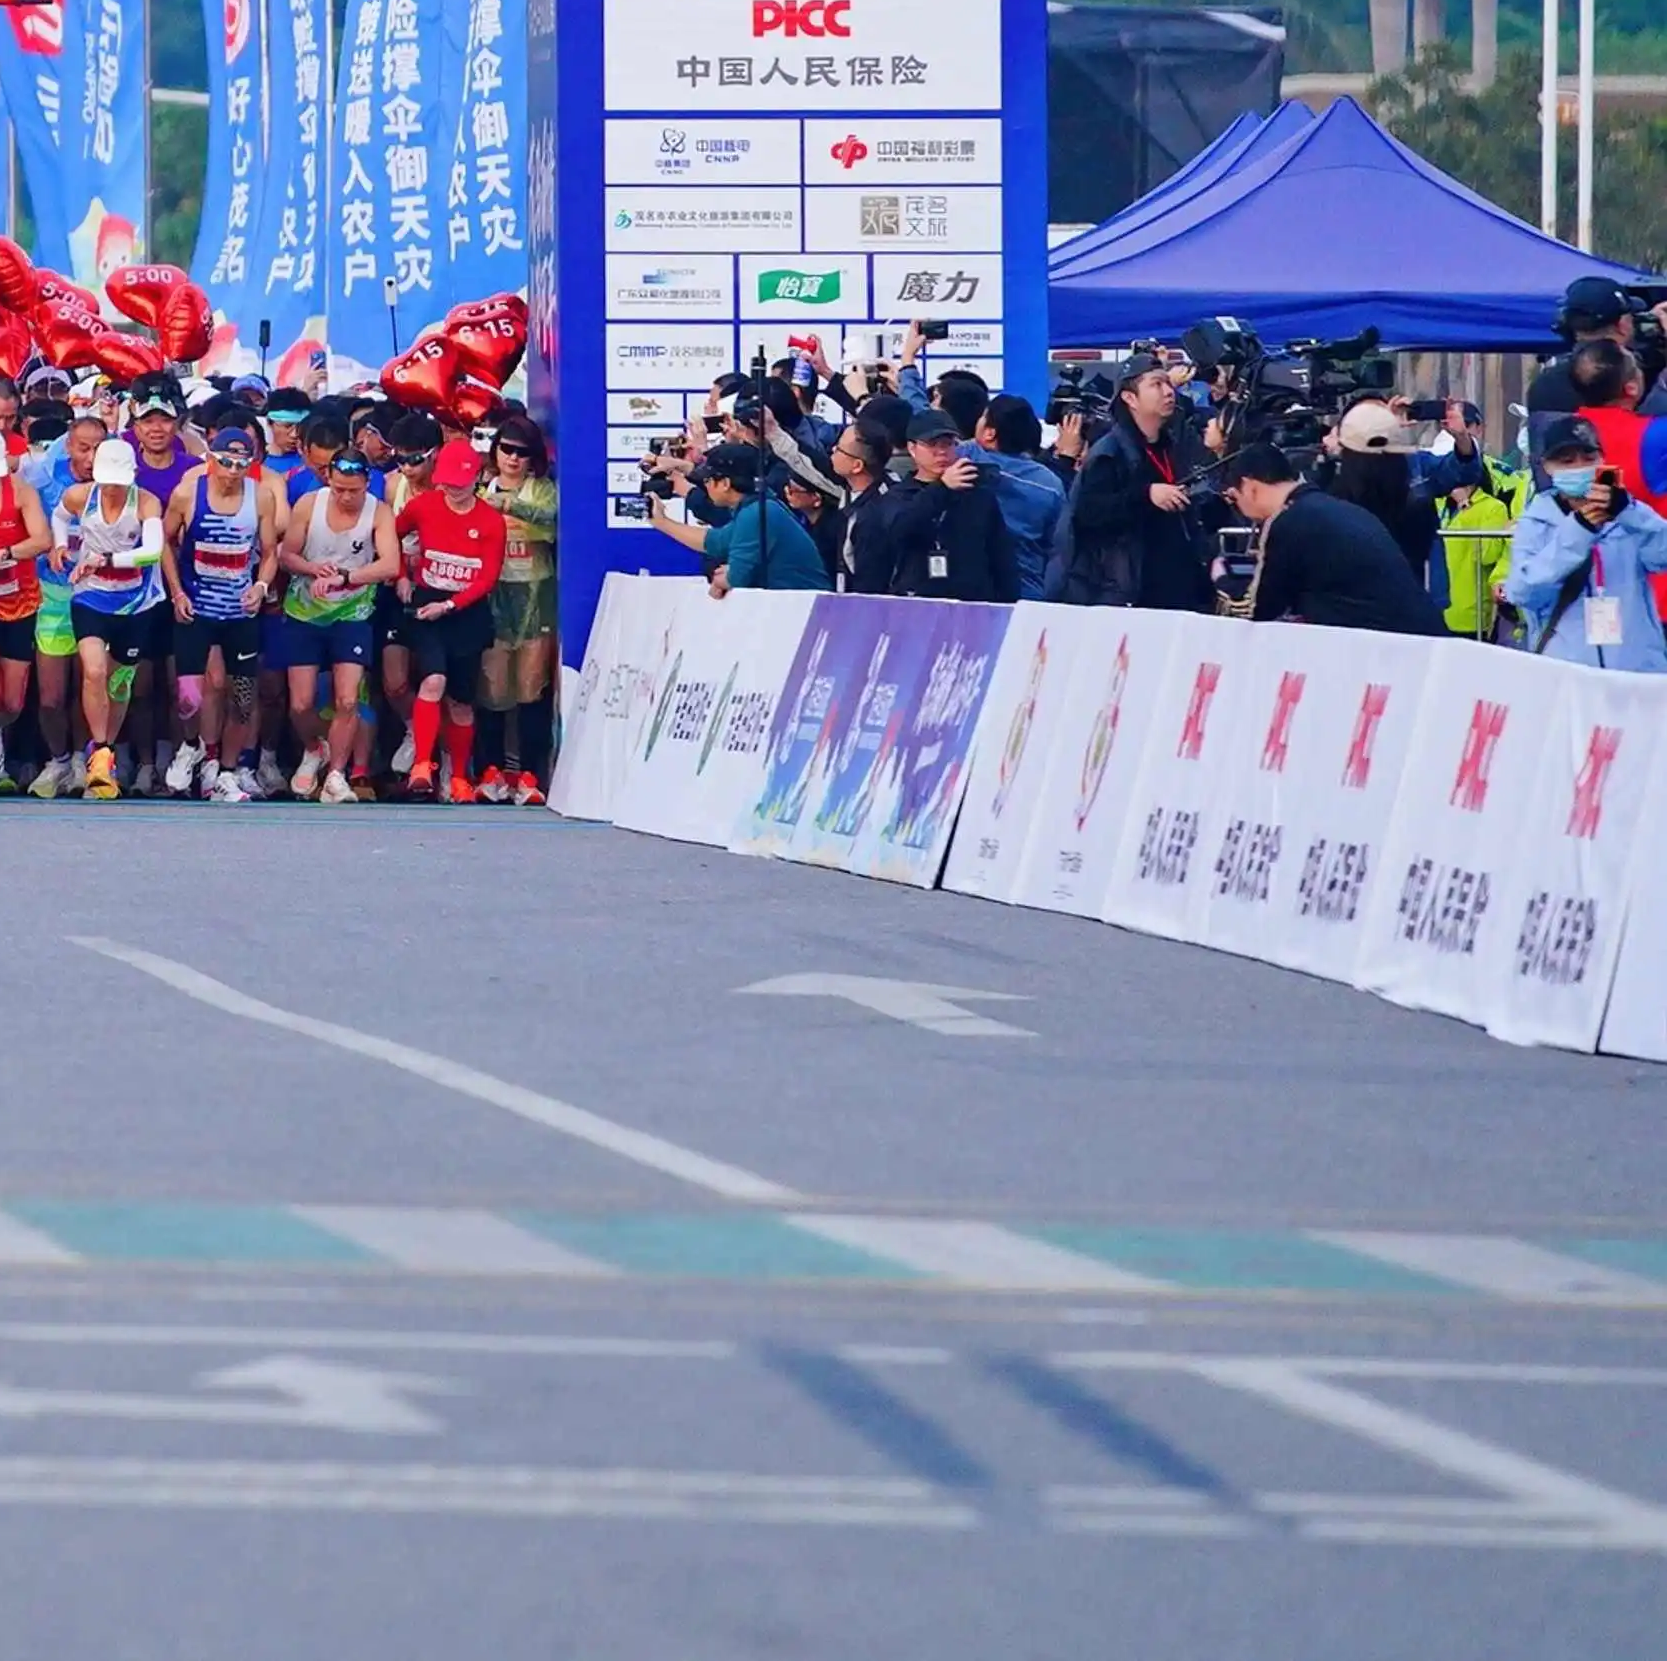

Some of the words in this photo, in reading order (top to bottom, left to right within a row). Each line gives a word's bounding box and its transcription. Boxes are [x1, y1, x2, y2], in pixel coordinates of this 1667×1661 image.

[752, 0, 851, 37] PICC
[676, 55, 928, 88] 中国人民保险
[877, 140, 975, 156] 中国福利彩票
[124, 268, 173, 285] 5:00
[897, 271, 979, 302] 魔力
[56, 305, 103, 336] 5:00
[457, 318, 515, 343] 6:15
[393, 340, 444, 384] 6:15
